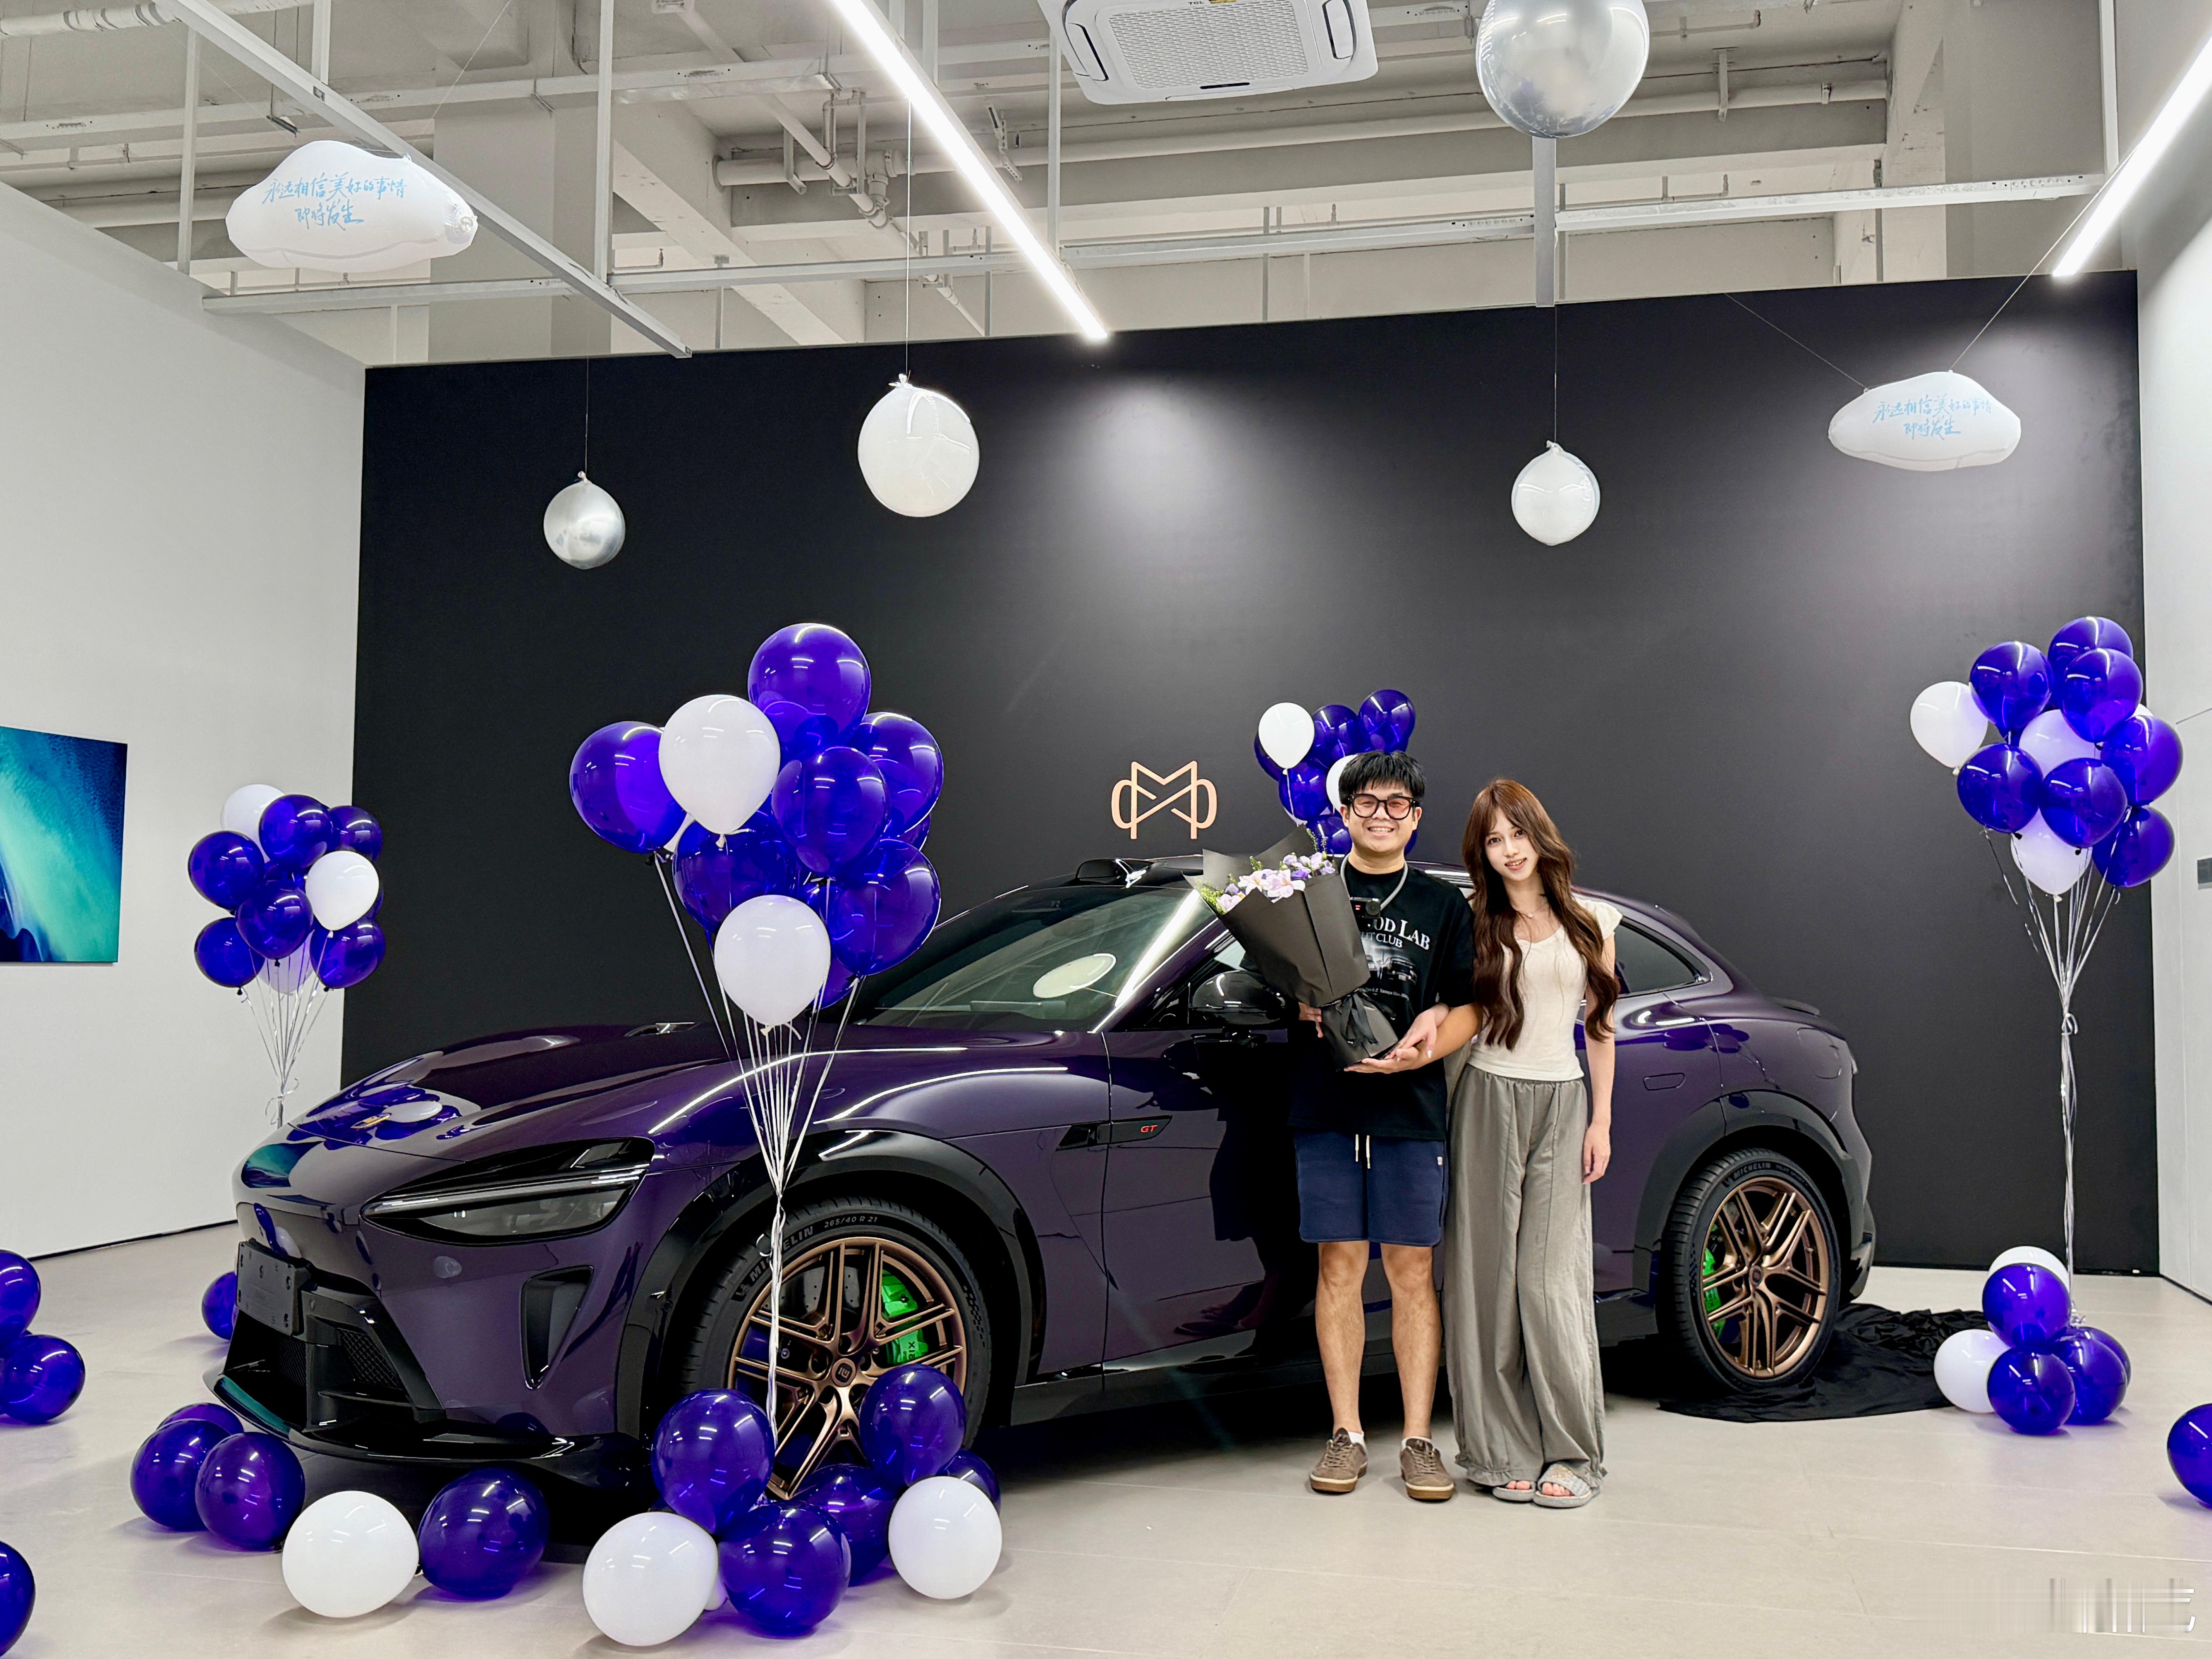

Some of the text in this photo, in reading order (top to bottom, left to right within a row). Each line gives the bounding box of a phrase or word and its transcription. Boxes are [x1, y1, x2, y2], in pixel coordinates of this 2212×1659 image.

[262, 171, 408, 204] 永远相信美好的事情
[295, 198, 364, 231] 即将发生
[1872, 393, 1993, 423] 永远相信美好的事情
[1903, 416, 1961, 441] 即将发生
[1376, 933, 1403, 948] CLUB
[1140, 1124, 1158, 1133] GT
[749, 1225, 814, 1283] MIELIN
[824, 1216, 857, 1228] 265/40
